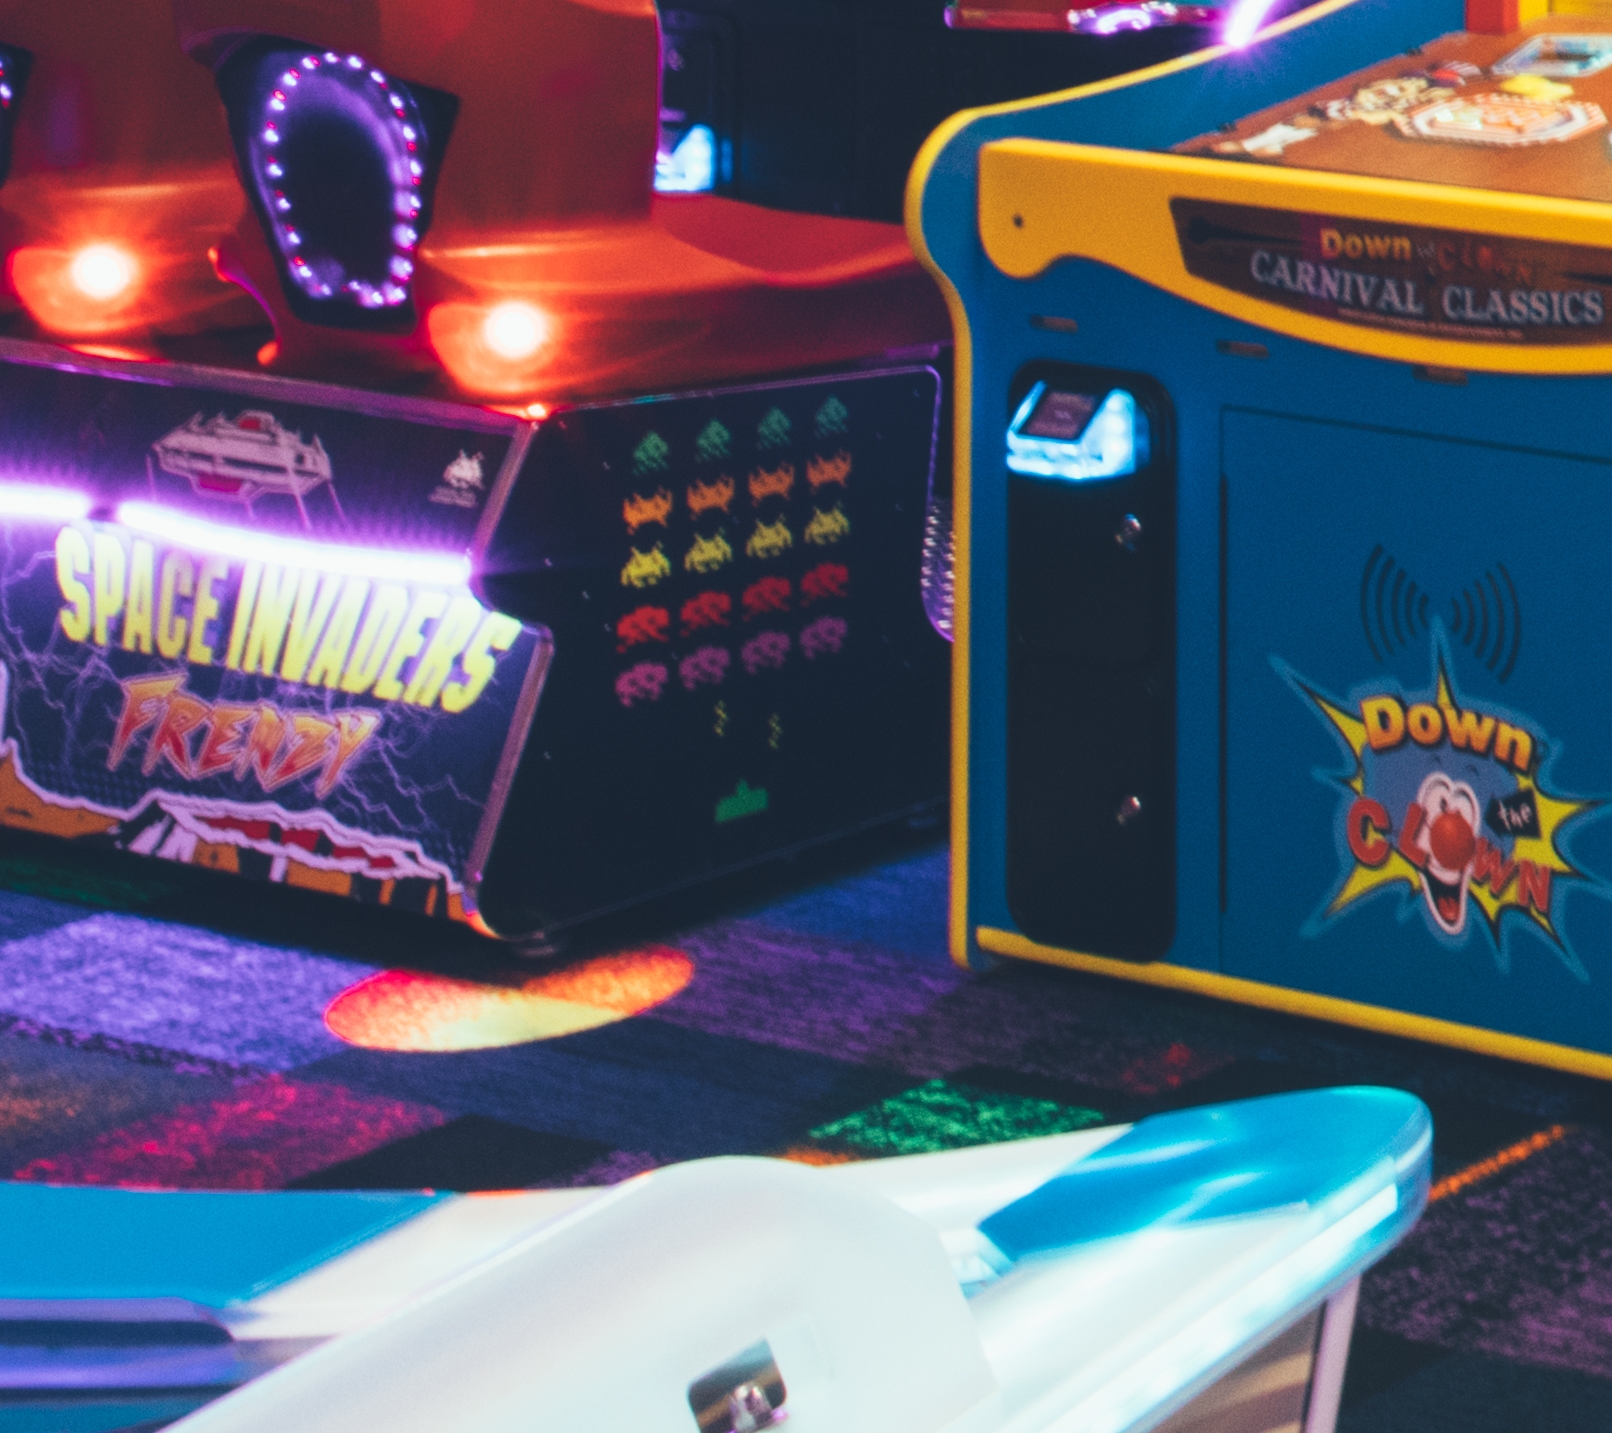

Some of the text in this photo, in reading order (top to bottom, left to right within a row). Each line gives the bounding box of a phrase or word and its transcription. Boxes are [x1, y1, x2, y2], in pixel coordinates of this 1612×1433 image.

[1249, 248, 1426, 316] CARNIVAL
[1441, 283, 1606, 326] CLASSICS
[55, 524, 523, 715] SPACE INVADERS
[108, 669, 382, 800] FRENZY
[1359, 694, 1534, 771] Down
[1497, 801, 1533, 832] the
